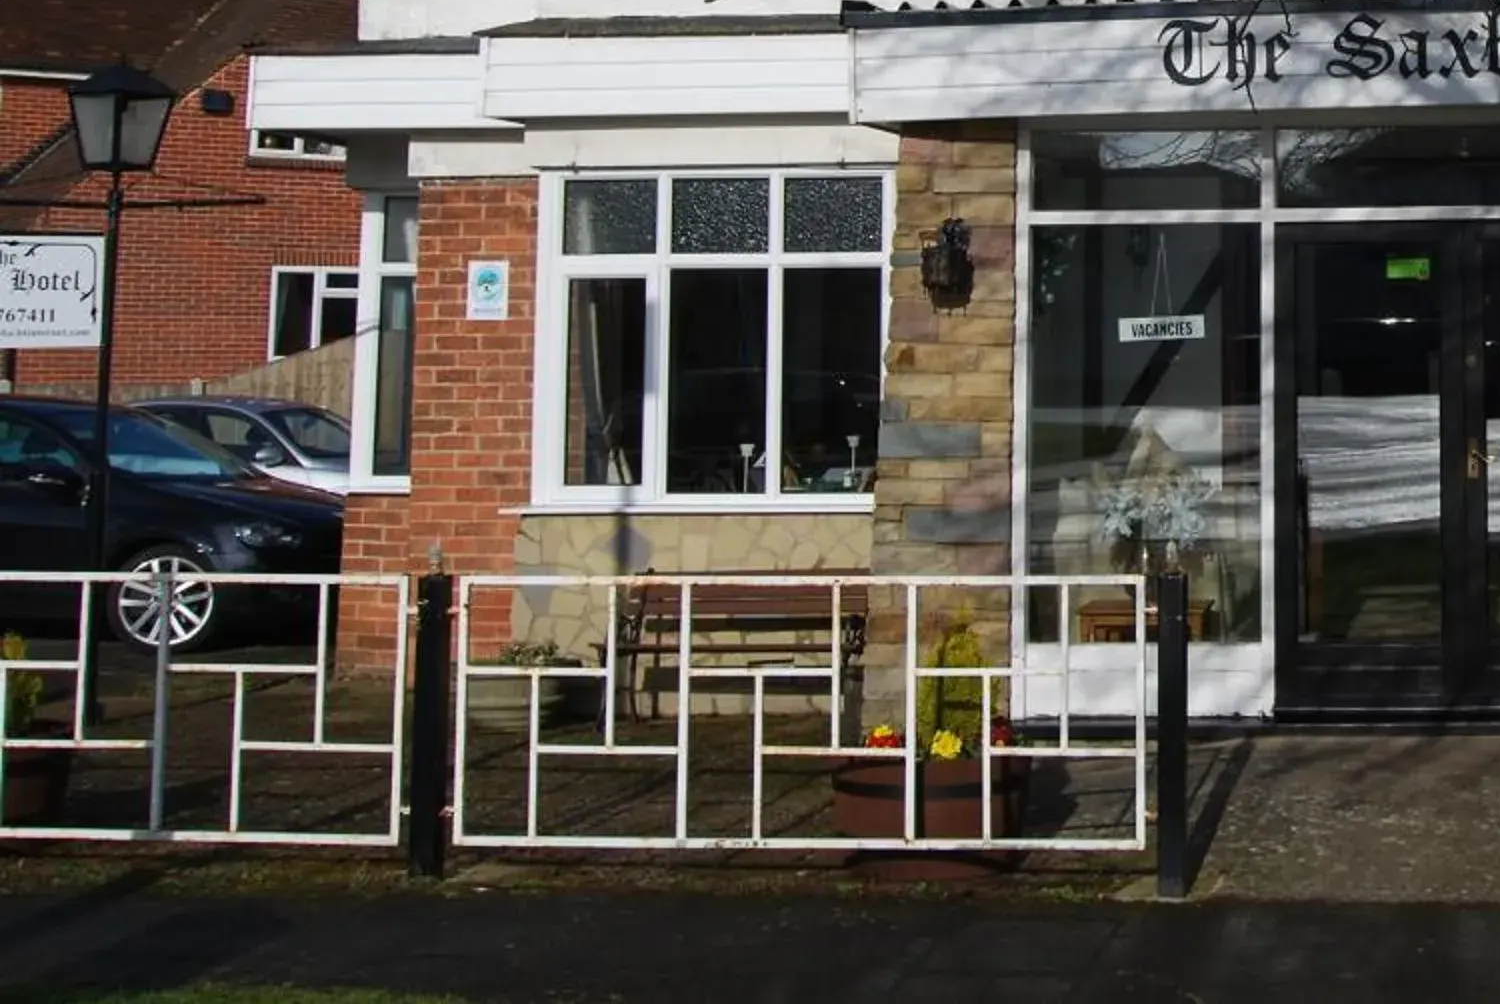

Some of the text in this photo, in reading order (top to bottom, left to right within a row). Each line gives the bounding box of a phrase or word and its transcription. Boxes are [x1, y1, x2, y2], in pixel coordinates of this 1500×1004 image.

[1157, 15, 1292, 90] The
[0, 250, 17, 267] he
[11, 268, 80, 295] Hotel
[1131, 321, 1193, 337] VACANCIES
